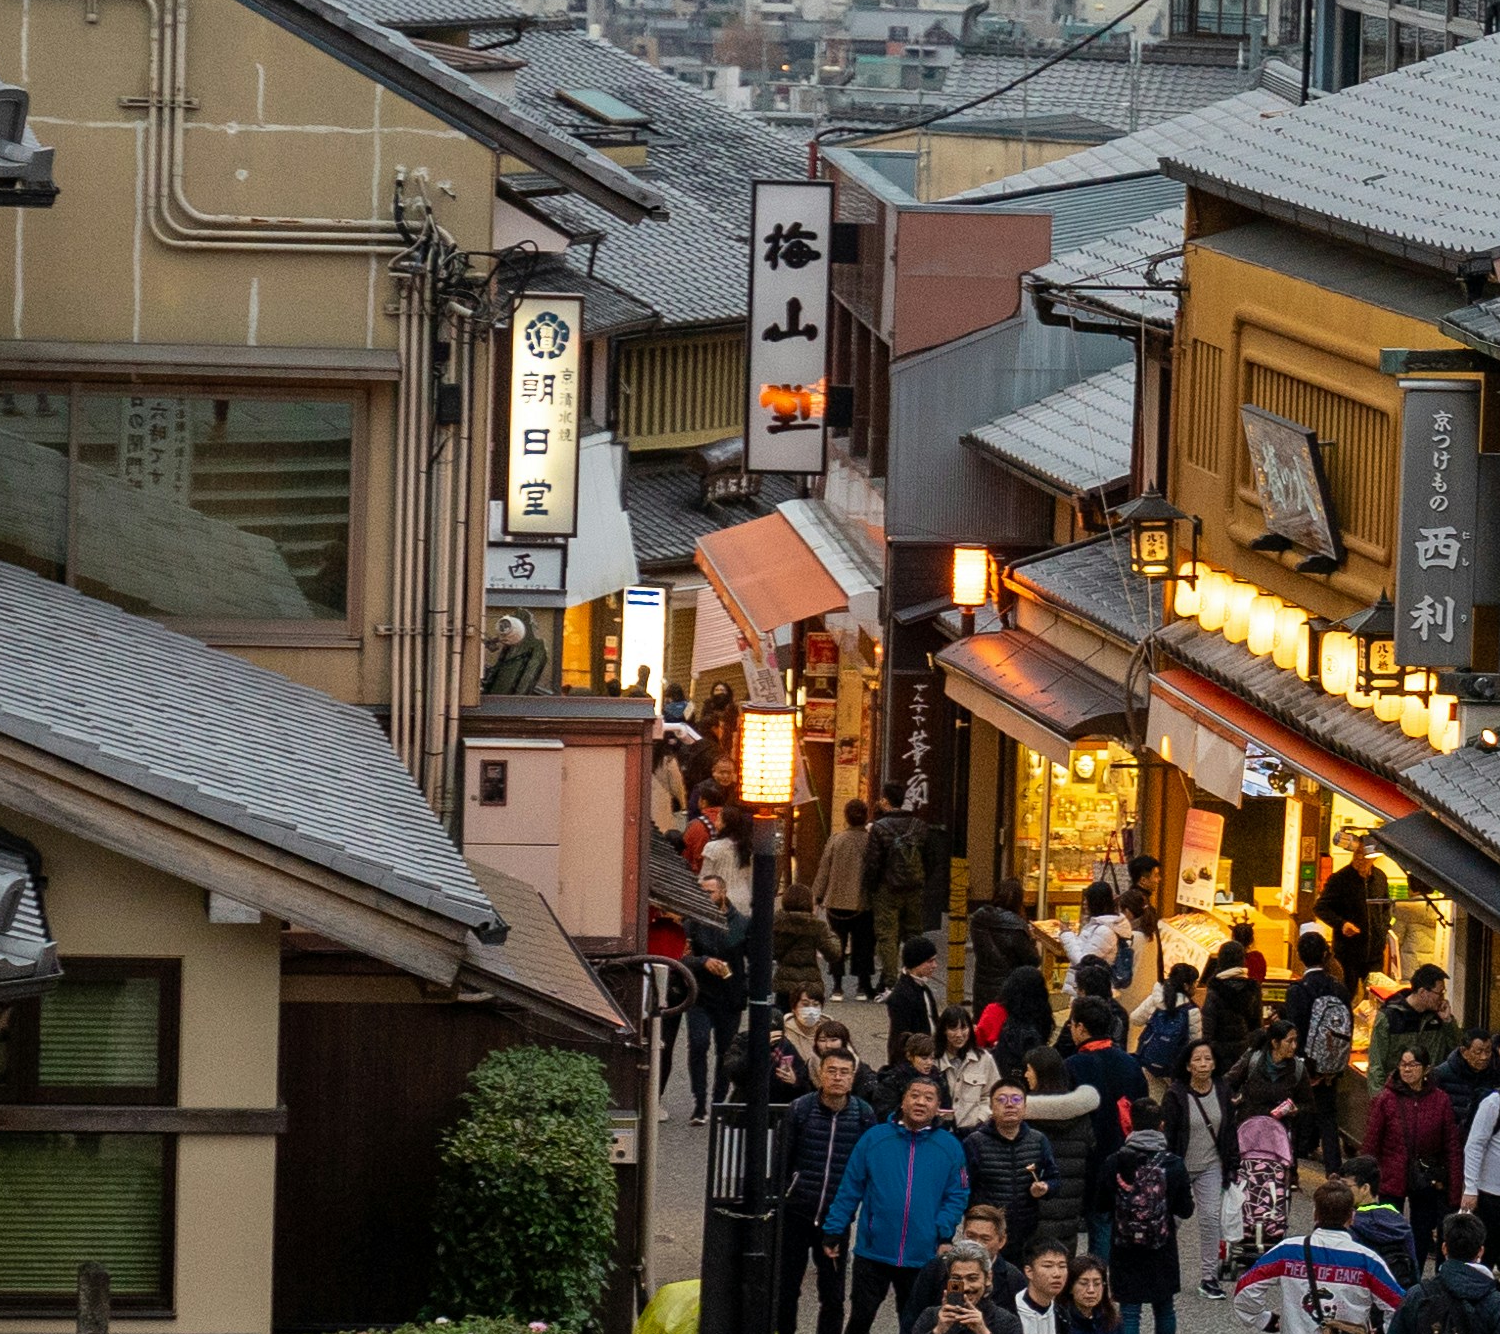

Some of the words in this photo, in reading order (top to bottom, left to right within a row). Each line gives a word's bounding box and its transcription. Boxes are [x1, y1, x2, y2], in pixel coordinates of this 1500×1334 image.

[761, 222, 822, 435] 梅山堂
[520, 370, 556, 517] 朝日堂
[1429, 409, 1454, 512] 京つけもの
[508, 553, 536, 581] 西
[1409, 526, 1461, 644] 西利
[1283, 1261, 1308, 1278] PIEC
[1317, 1265, 1333, 1281] OF
[1334, 1267, 1365, 1285] CAKE
